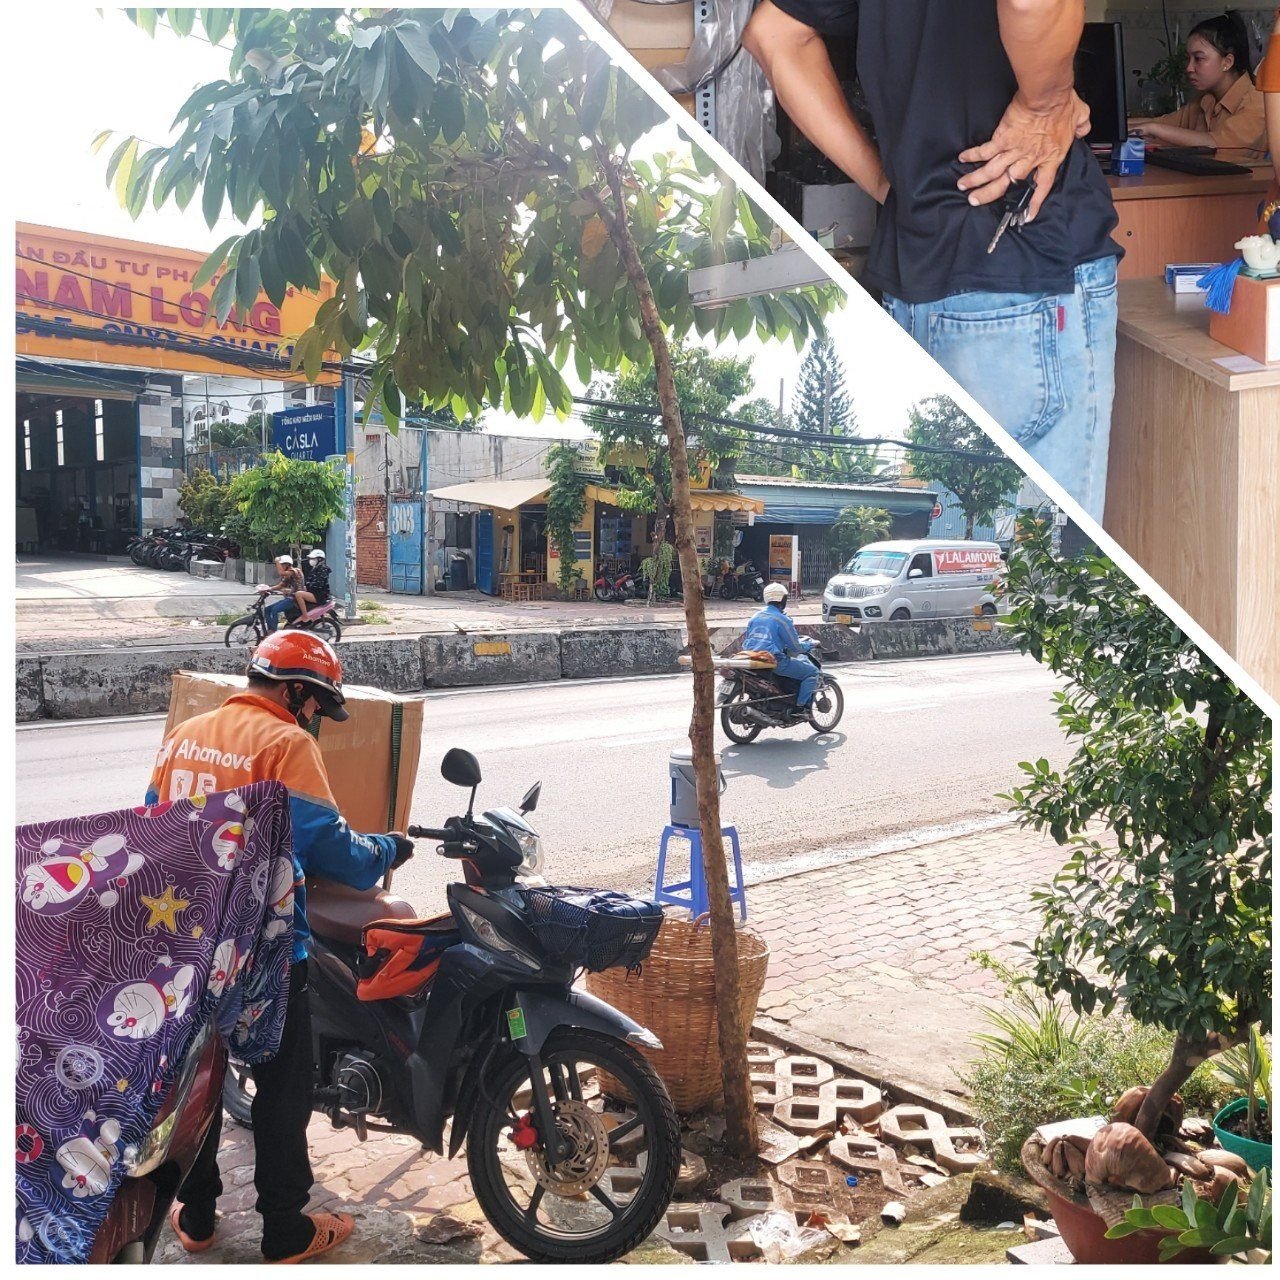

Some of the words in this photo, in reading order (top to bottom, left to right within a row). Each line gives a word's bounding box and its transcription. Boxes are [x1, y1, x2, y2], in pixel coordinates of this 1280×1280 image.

[53, 250, 107, 270] ĐẦU
[115, 259, 150, 276] TƯ
[16, 268, 133, 319] NAM
[945, 551, 1001, 564] LALAMOVE
[303, 653, 331, 667] Ahamove
[175, 738, 252, 772] Ahamove
